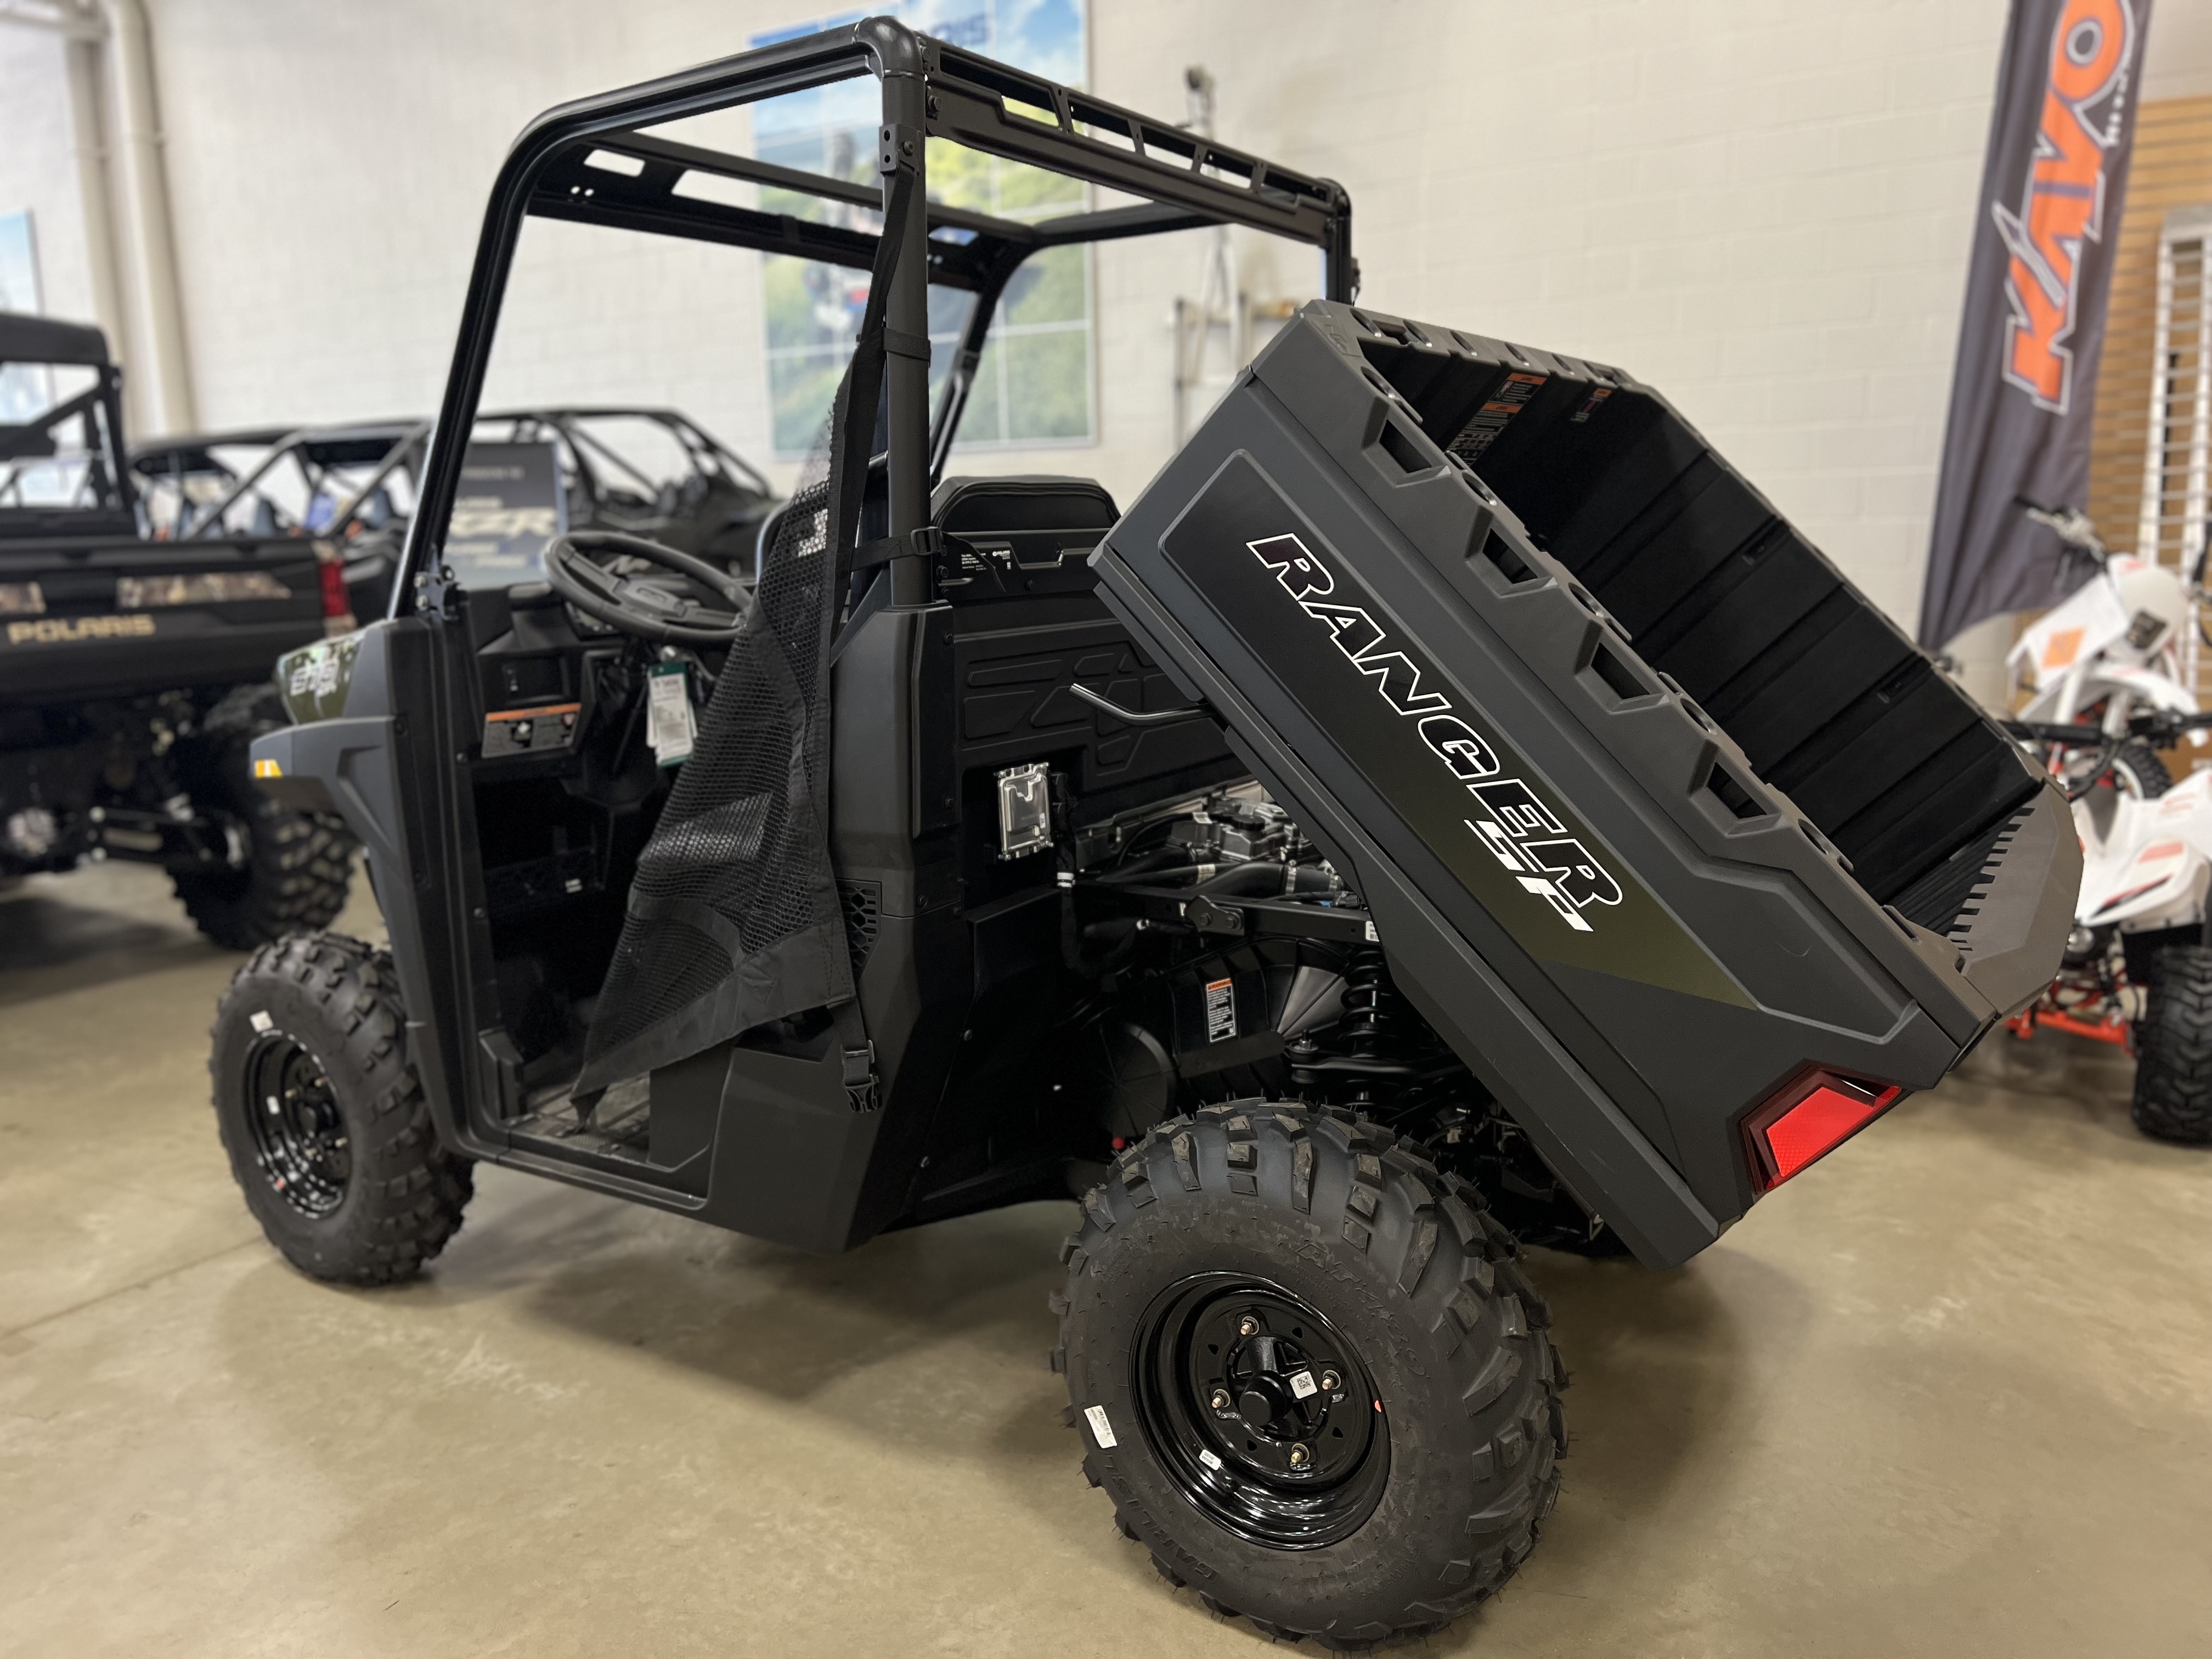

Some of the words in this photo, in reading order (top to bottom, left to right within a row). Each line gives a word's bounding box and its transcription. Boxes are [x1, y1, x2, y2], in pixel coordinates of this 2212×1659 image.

[7, 614, 156, 645] POLARIS
[1245, 533, 1623, 907] RANGER
[1464, 819, 1594, 932] SP
